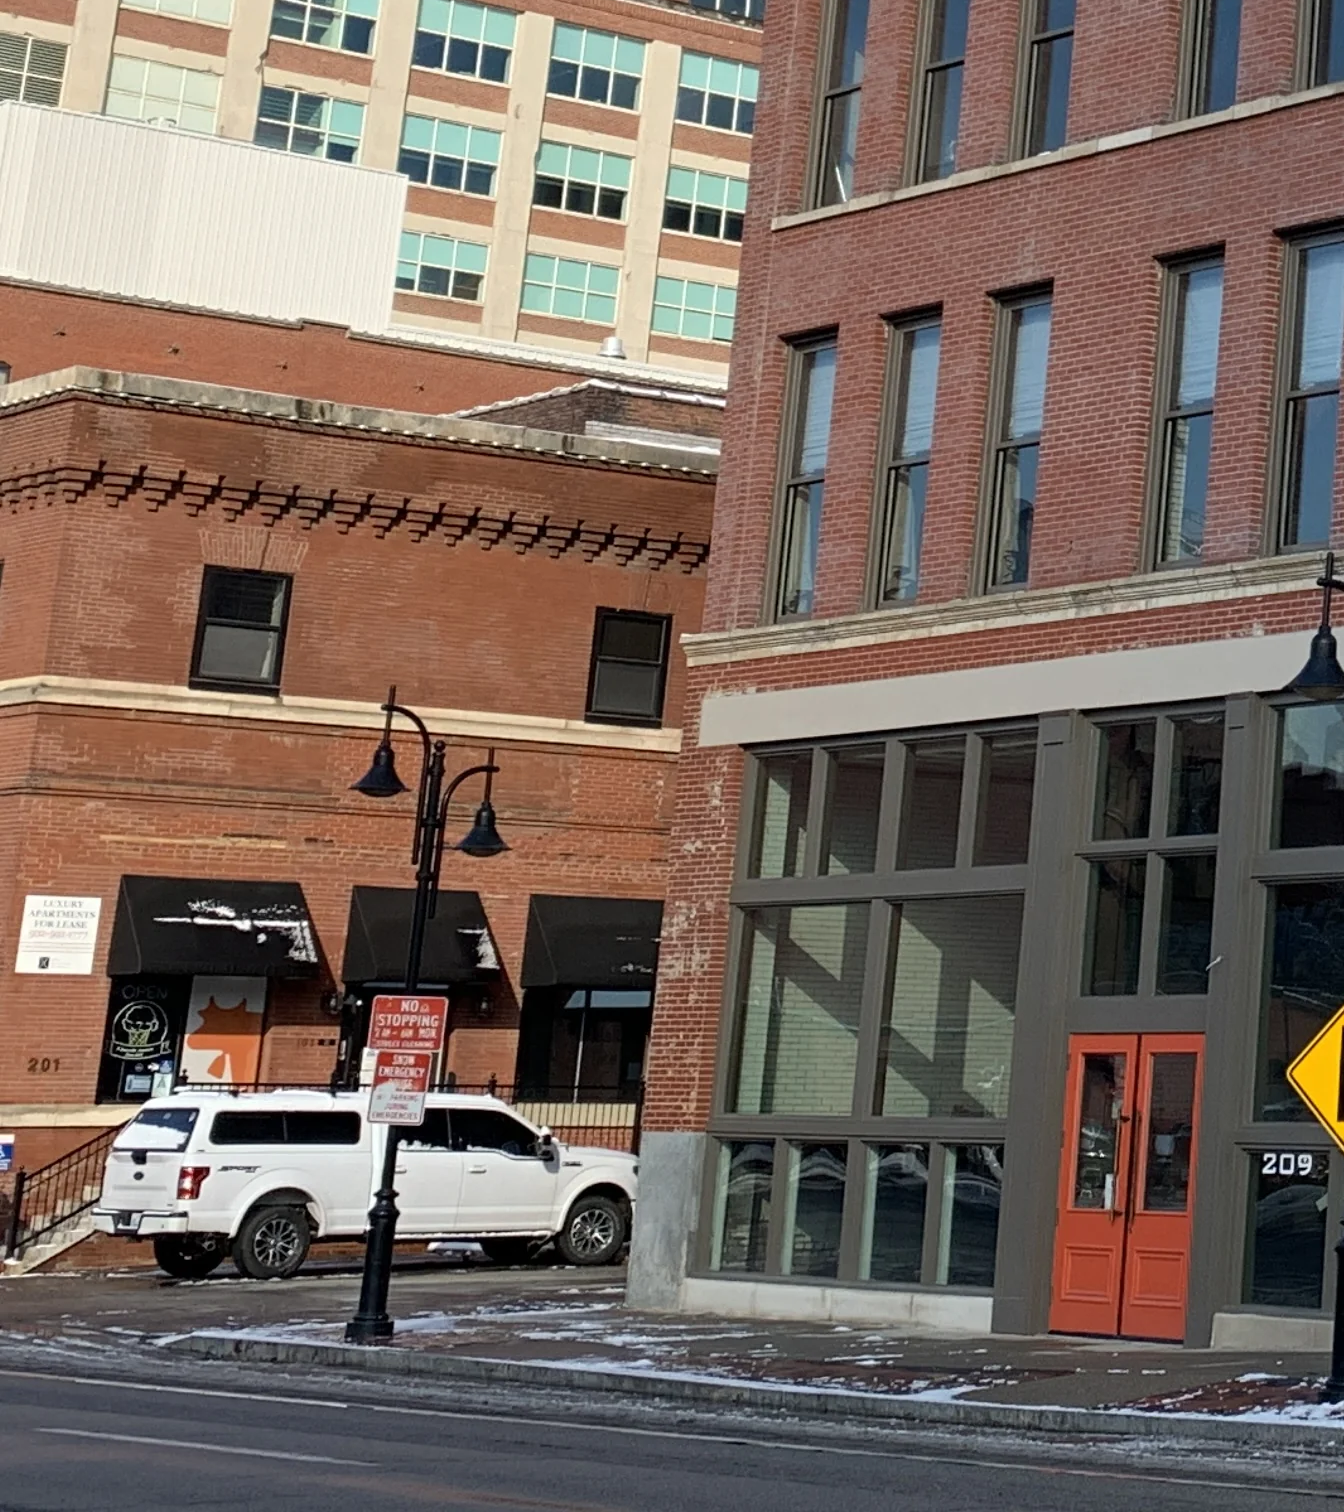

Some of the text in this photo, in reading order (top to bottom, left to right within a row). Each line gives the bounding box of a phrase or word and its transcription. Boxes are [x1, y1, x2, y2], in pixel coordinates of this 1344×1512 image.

[43, 899, 84, 908] LUXURY
[28, 909, 96, 919] APARTMENTS
[33, 919, 88, 929] FOR LEASE
[121, 983, 168, 1000] OPEN
[400, 999, 420, 1013] NO
[378, 1013, 440, 1028] STOPPING
[27, 1057, 61, 1073] 201
[378, 1066, 426, 1078] EMERGENCY
[1261, 1152, 1313, 1175] 209
